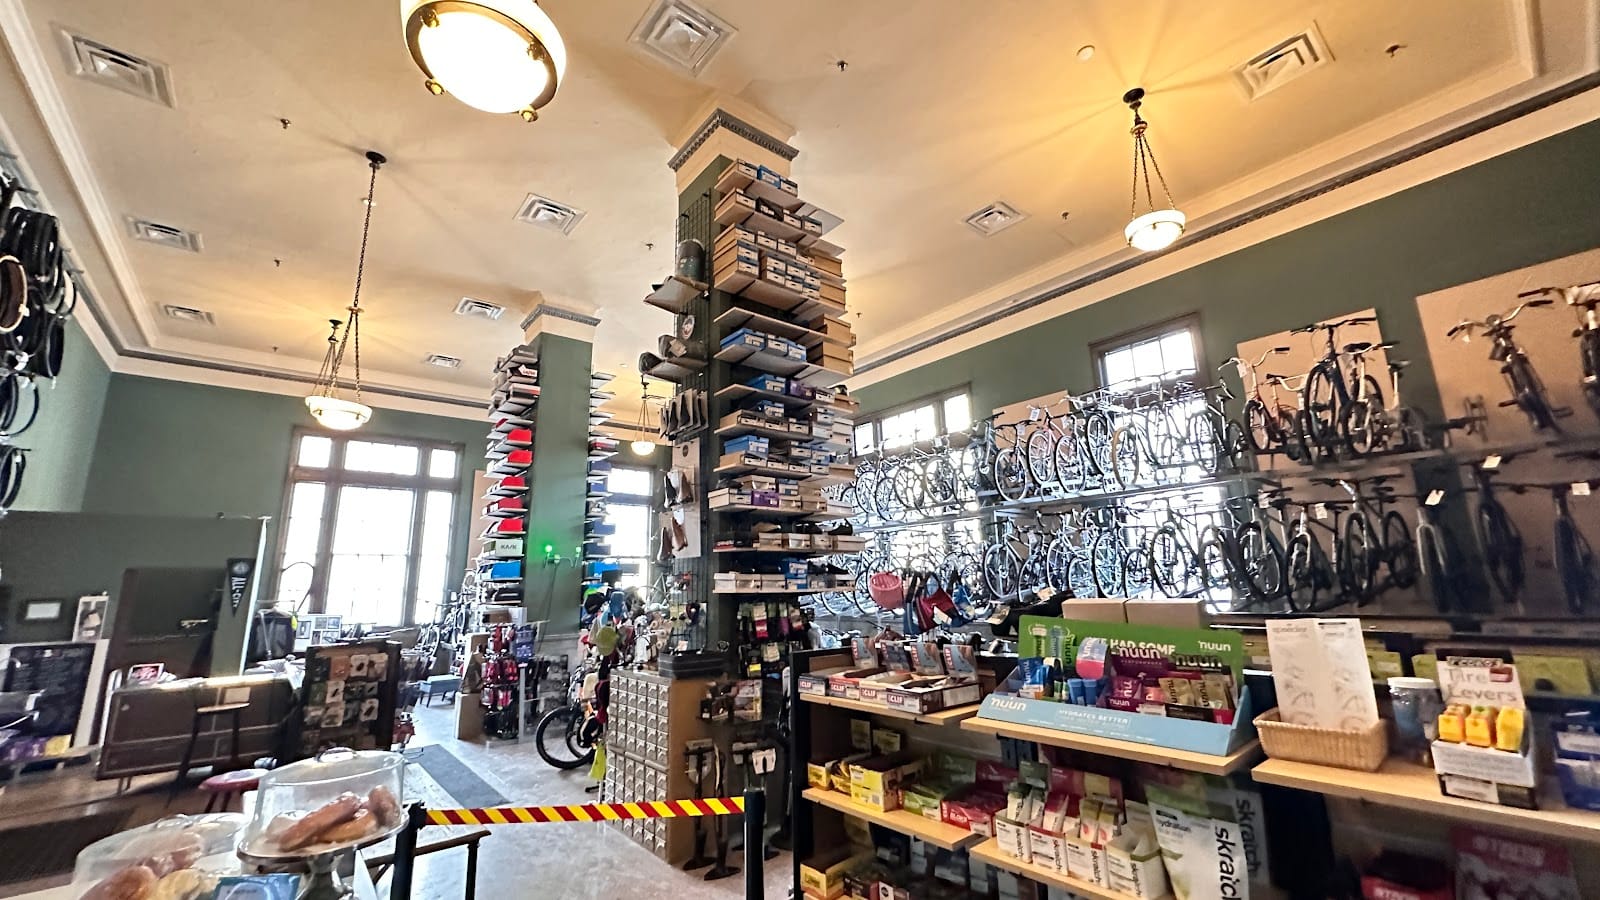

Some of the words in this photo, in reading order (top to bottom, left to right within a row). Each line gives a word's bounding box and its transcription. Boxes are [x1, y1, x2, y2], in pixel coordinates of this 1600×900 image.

[231, 576, 247, 608] ALL-CITY
[1198, 640, 1231, 651] nuun
[1116, 645, 1161, 659] nuun
[1174, 655, 1222, 668] nuun
[800, 681, 812, 689] CLIF
[832, 684, 845, 692] CLIF
[863, 689, 876, 698] CLIF
[889, 695, 903, 704] CLIF
[991, 697, 1027, 711] nuun
[1215, 824, 1242, 900] skratc
